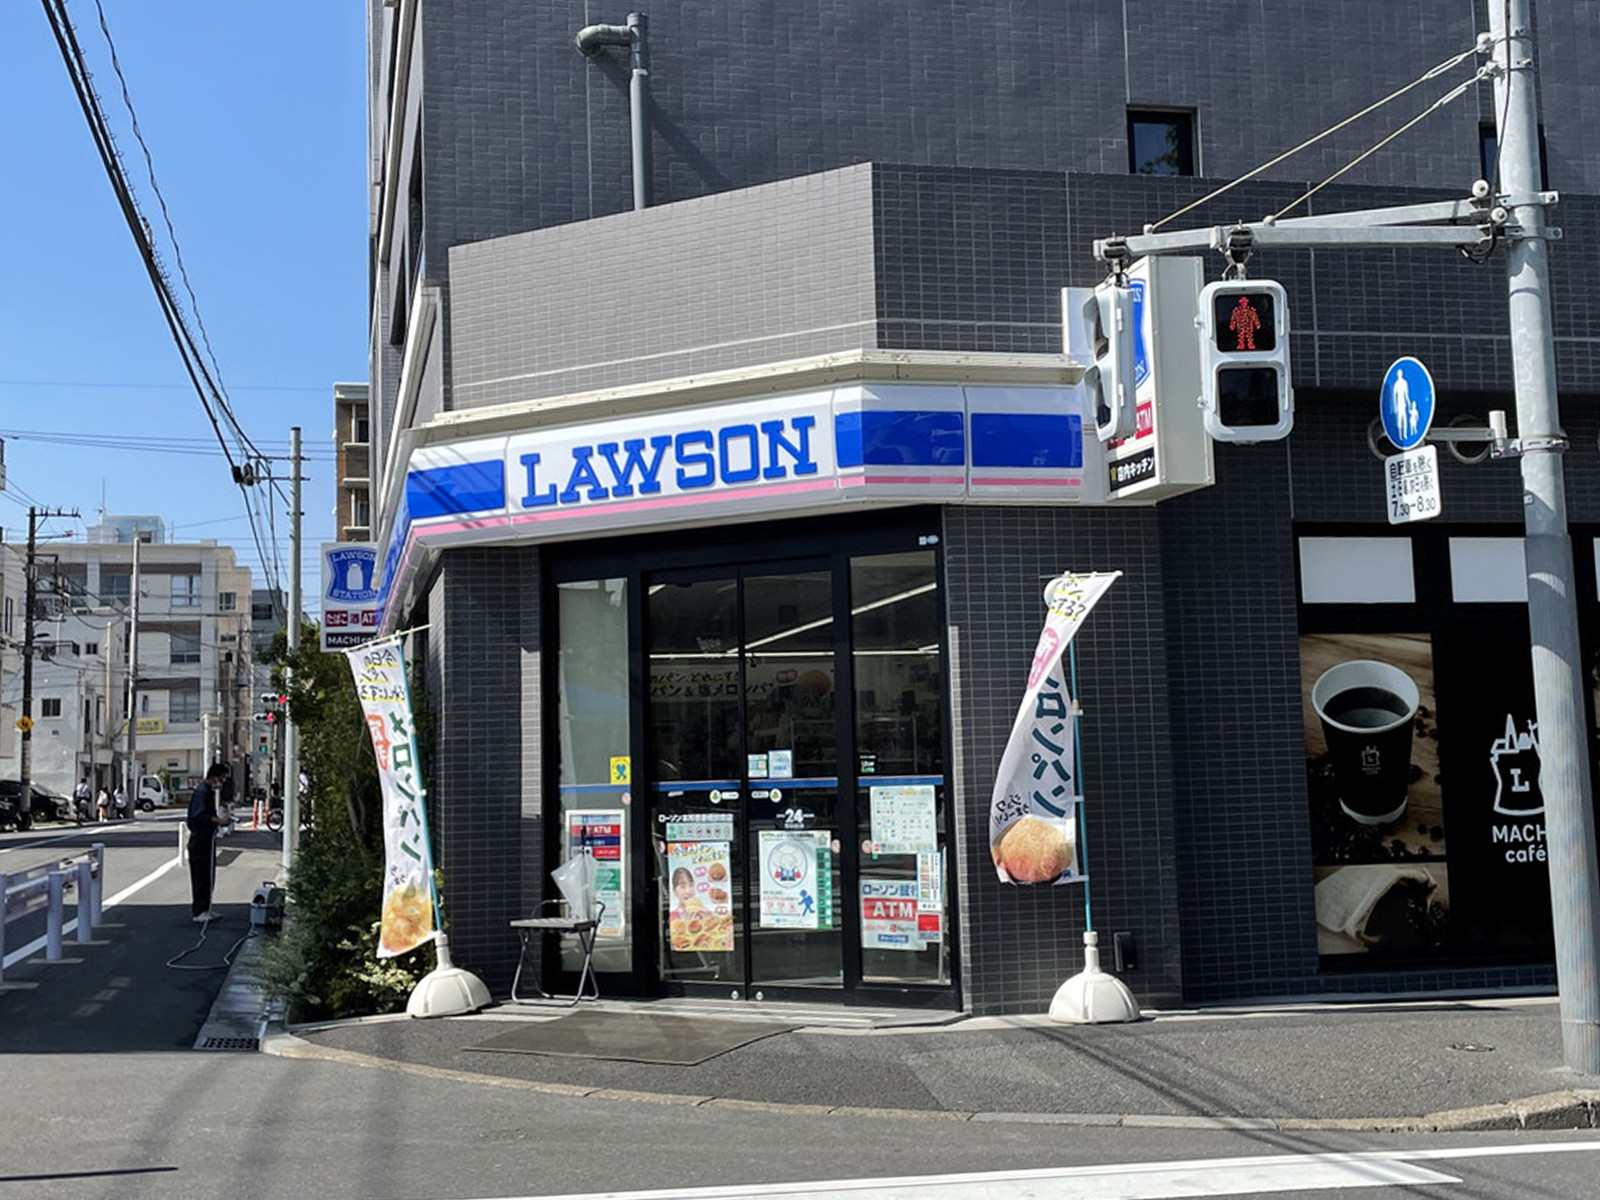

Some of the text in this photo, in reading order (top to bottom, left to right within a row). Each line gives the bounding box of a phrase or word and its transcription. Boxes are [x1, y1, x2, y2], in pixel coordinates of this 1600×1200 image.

[520, 415, 818, 508] LAWSON
[362, 612, 376, 625] AT
[327, 636, 360, 645] MACHI
[1510, 768, 1530, 792] L
[785, 808, 804, 824] 24
[1492, 824, 1547, 843] MACH
[1505, 845, 1546, 863] café
[873, 902, 913, 918] ATM
